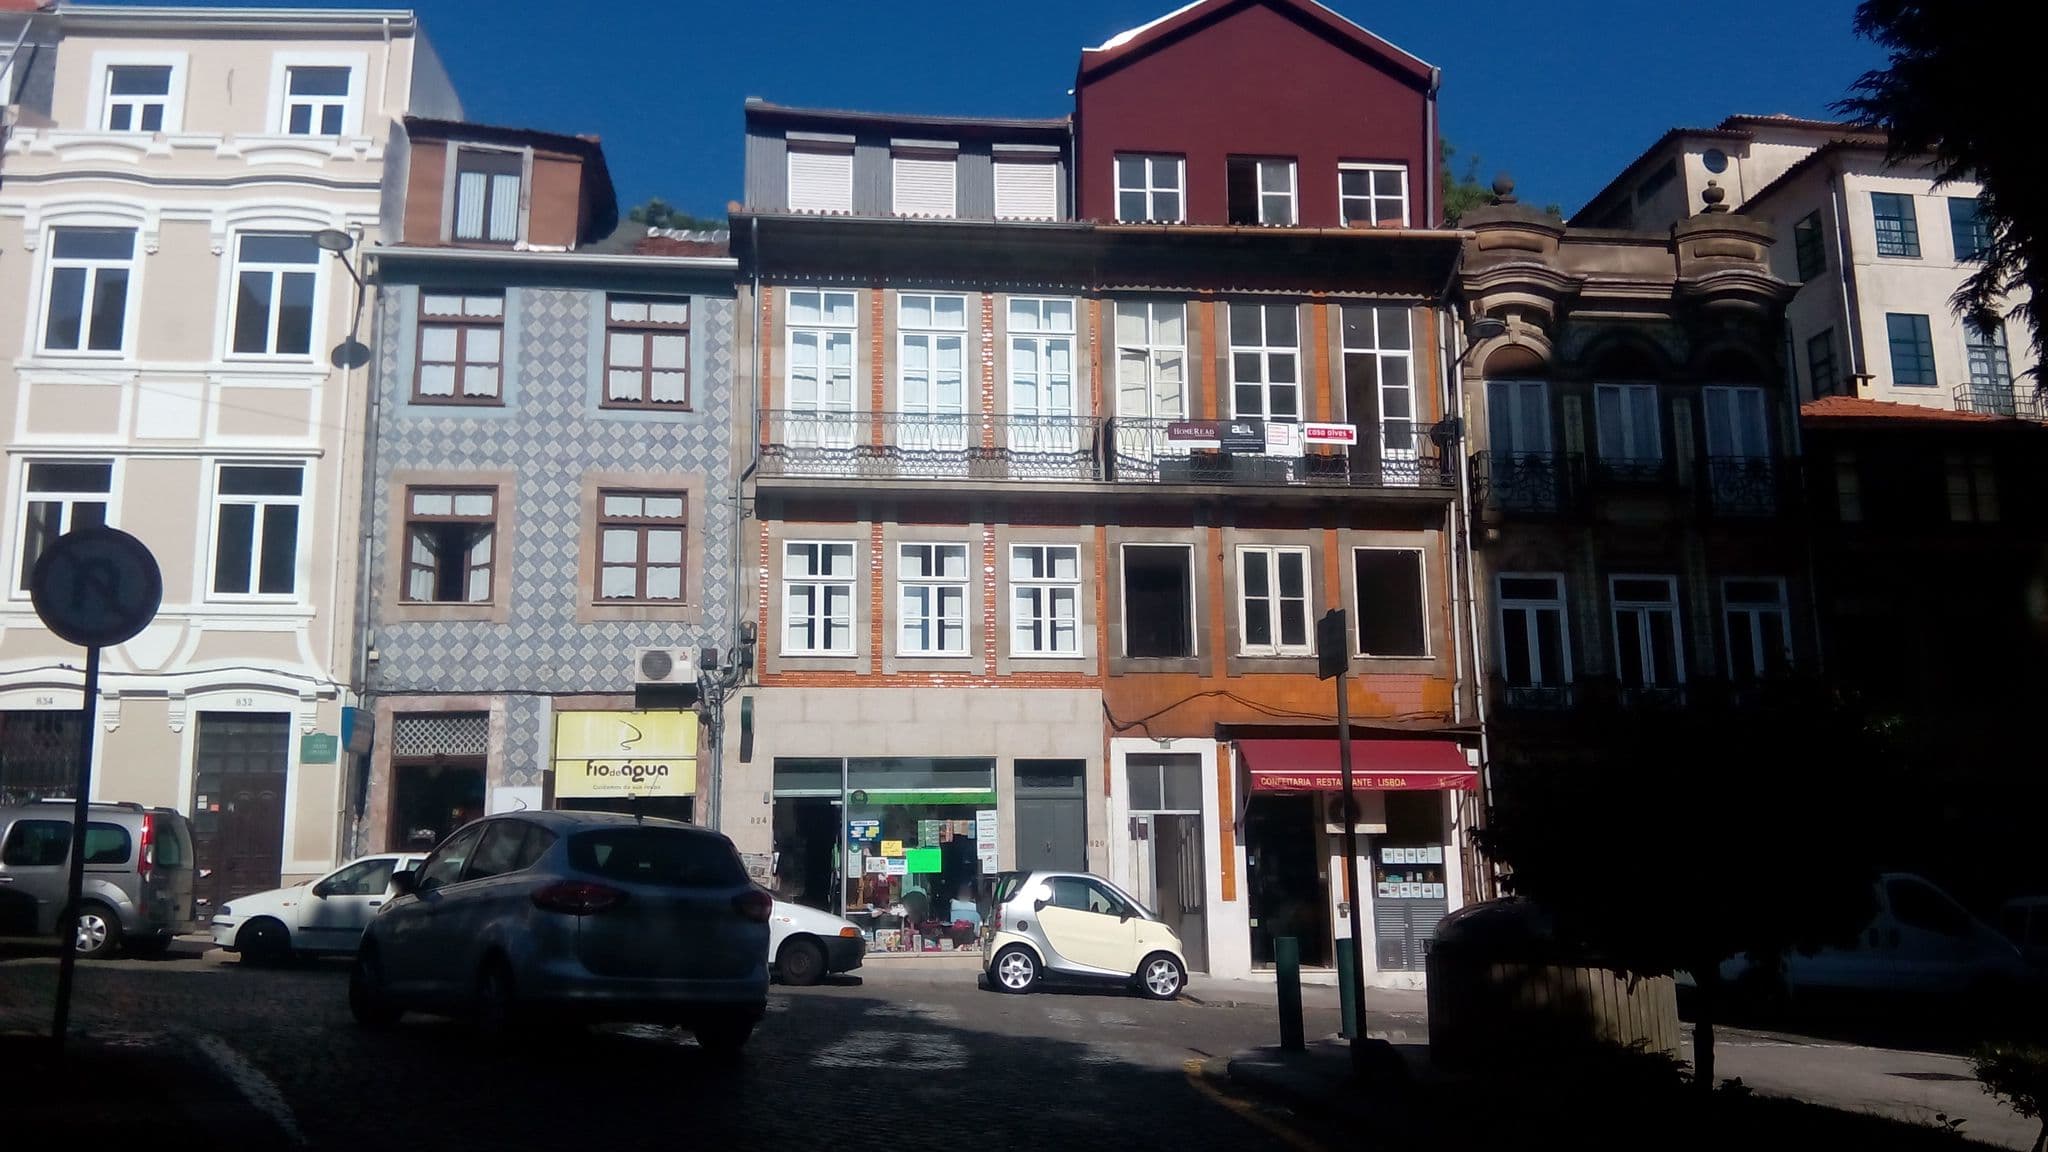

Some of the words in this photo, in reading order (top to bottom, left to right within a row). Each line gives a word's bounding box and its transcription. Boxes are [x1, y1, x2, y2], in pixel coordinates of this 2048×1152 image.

[36, 697, 53, 705] 834
[236, 698, 253, 706] 832
[1260, 776, 1311, 787] CONFEITARIA
[1316, 777, 1372, 787] RESTAANTE
[1378, 777, 1406, 787] LISBOA
[750, 816, 767, 824] 824
